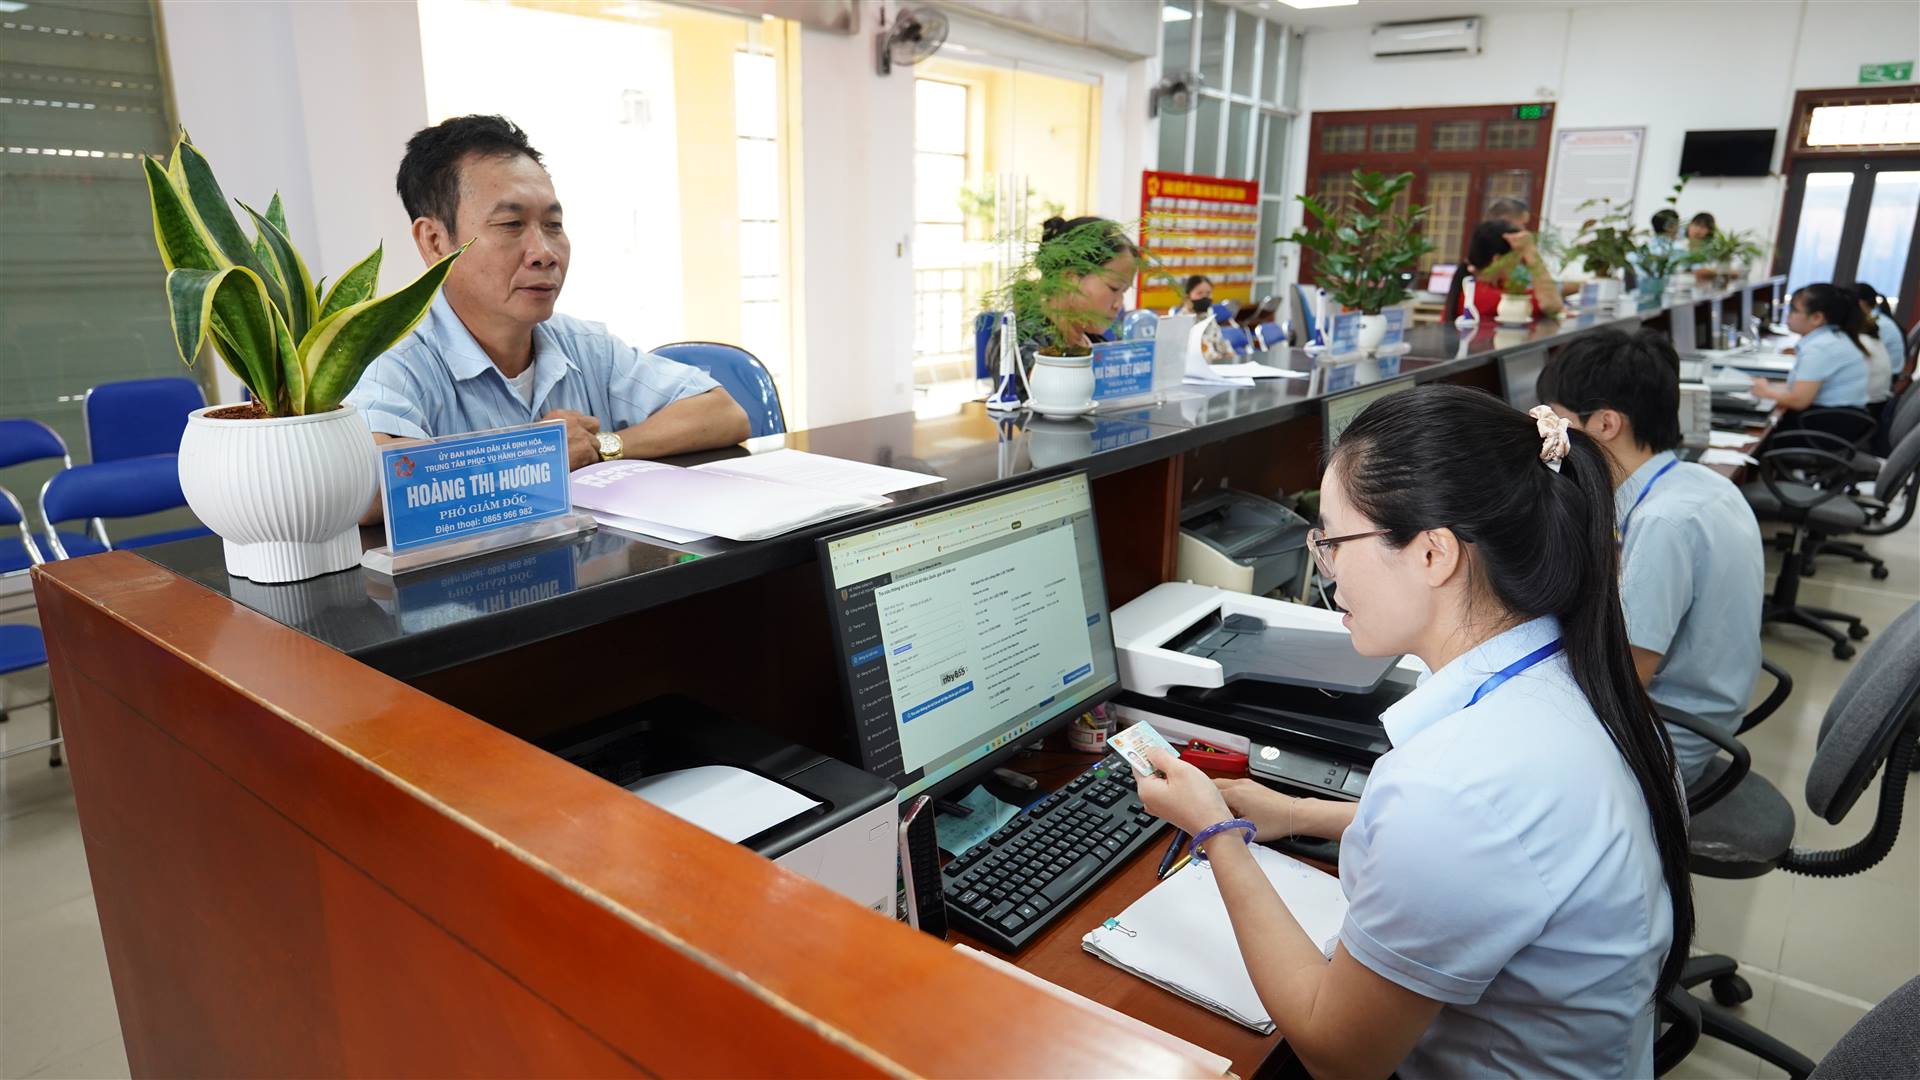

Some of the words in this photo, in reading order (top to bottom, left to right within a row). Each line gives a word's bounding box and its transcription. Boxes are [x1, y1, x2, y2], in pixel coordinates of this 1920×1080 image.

[424, 462, 450, 474] TRUNG
[451, 459, 466, 469] TÂM
[467, 456, 486, 468] PHỤC
[488, 454, 497, 464] VỤ
[498, 450, 516, 462] HÀNH
[517, 446, 537, 459] CHÍNH
[538, 442, 556, 455] CÔNG
[450, 450, 465, 459] BAN
[466, 447, 486, 457] NHÂN
[486, 444, 501, 454] DÂN
[406, 477, 466, 509] HOÀNG
[469, 471, 496, 497] THỊ
[498, 462, 551, 491] HƯƠNG
[435, 522, 456, 535] Điện
[457, 518, 482, 529] thoại:
[482, 514, 502, 525] 0865
[503, 510, 518, 521] 966
[518, 506, 533, 517] 982
[439, 504, 467, 520] PHÓ
[468, 499, 500, 515] GIÁM
[502, 492, 528, 508] ĐỐC
